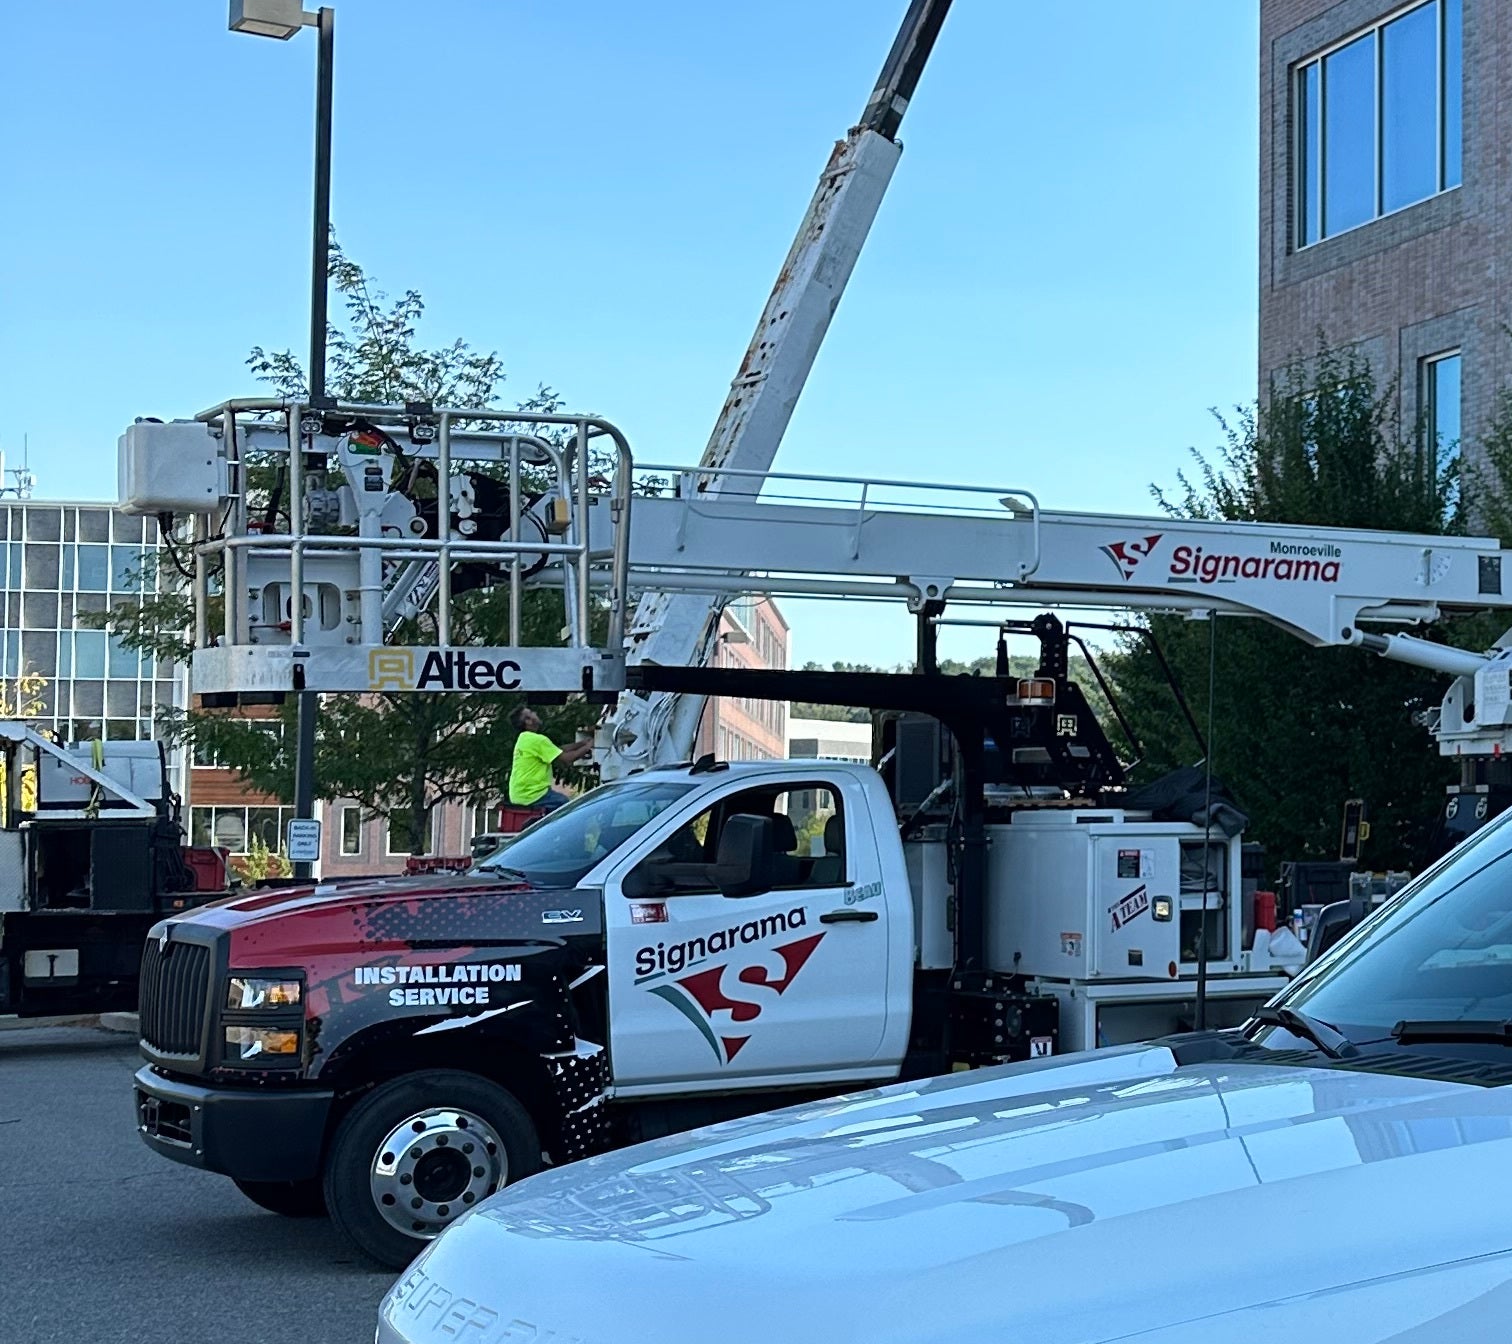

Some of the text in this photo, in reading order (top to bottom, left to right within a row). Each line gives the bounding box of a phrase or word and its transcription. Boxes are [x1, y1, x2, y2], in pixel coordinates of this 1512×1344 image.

[1270, 541, 1342, 558] Monroeville
[1169, 546, 1341, 584] Signarama
[416, 651, 522, 690] Altec
[635, 906, 807, 976] Signarama
[354, 964, 522, 985] INSTALLATION
[388, 986, 490, 1007] SERVICE
